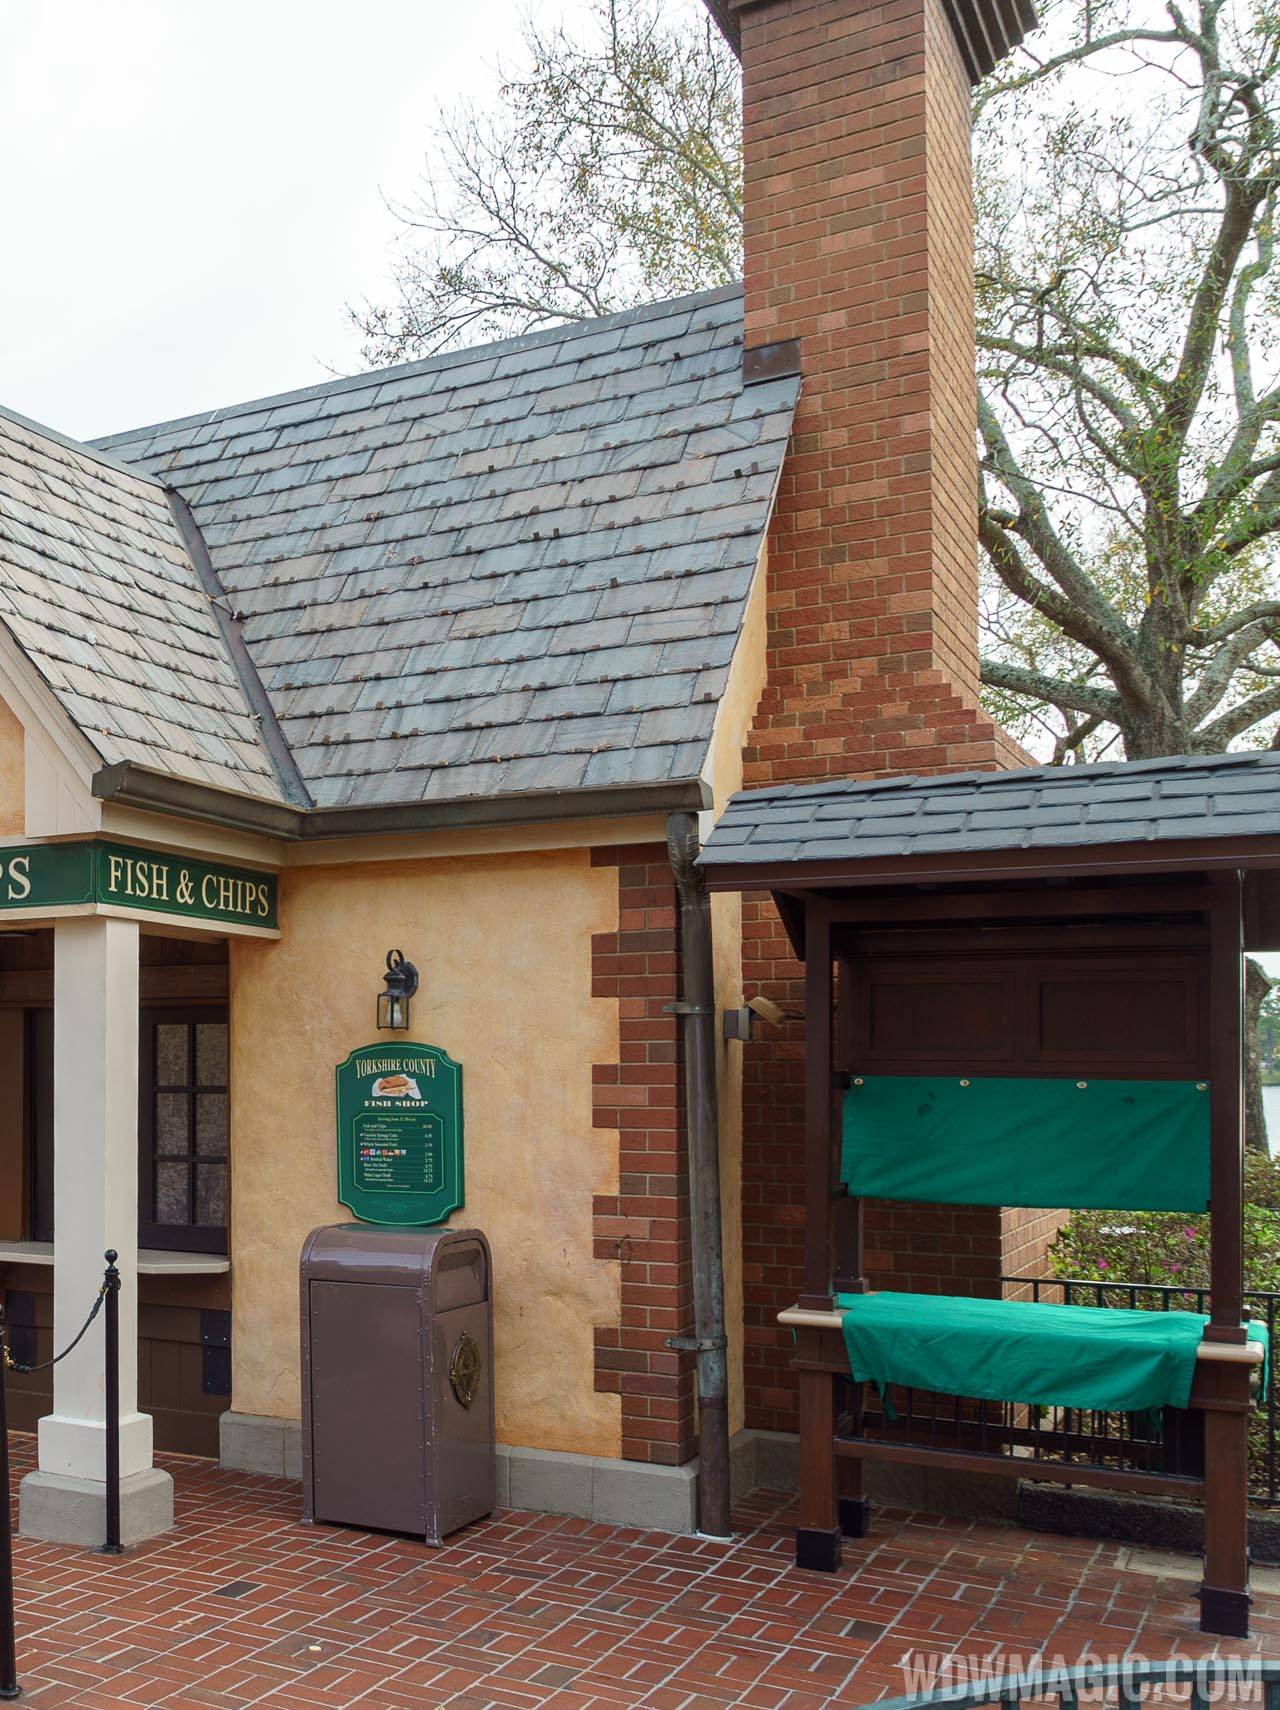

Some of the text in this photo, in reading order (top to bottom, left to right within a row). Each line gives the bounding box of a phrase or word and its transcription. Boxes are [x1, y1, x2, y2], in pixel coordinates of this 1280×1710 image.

[108, 855, 269, 917] FISH & CHIPS
[356, 1058, 436, 1078] YORKSHIRE COUNTY
